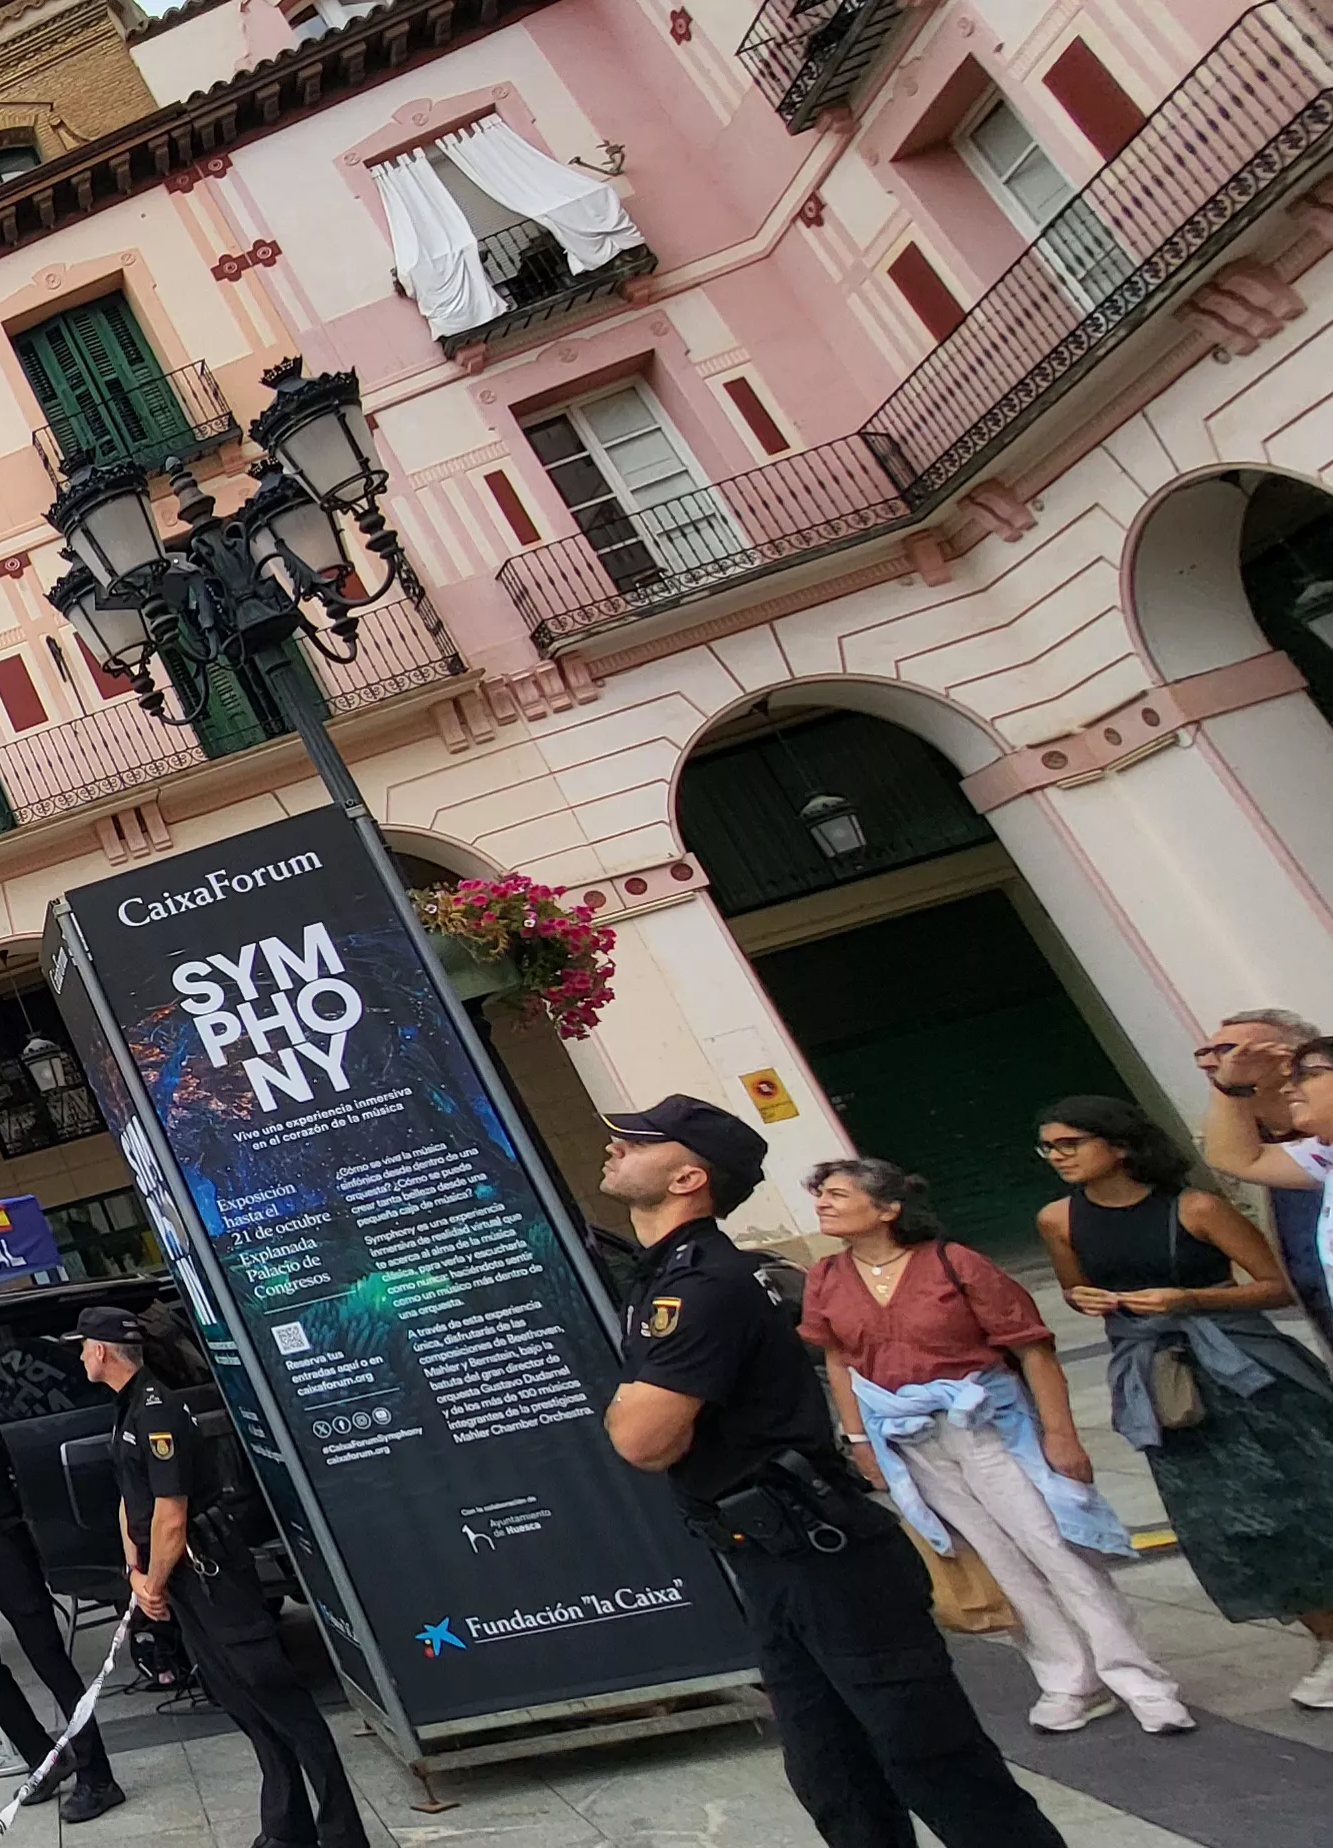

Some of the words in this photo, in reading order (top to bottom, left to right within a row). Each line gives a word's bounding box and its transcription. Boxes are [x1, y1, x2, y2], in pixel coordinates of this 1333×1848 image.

[117, 851, 323, 928] CaixaForum
[171, 921, 346, 1015] SYM
[192, 977, 363, 1068] PHO
[241, 1032, 351, 1113] NY
[233, 1130, 259, 1142] Vive
[262, 1124, 284, 1134] una
[285, 1103, 353, 1128] experiencia
[353, 1088, 412, 1108] inmersiva
[252, 1140, 267, 1150] en
[269, 1134, 281, 1145] el
[282, 1124, 329, 1141] corazón
[331, 1118, 346, 1128] de
[347, 1113, 360, 1123] la
[361, 1103, 404, 1120] música
[216, 1181, 297, 1213] Exposición
[222, 1206, 264, 1229] hasta
[265, 1203, 279, 1217] el
[231, 1229, 251, 1246] 21
[255, 1225, 274, 1240] de
[275, 1212, 331, 1233] octubre
[239, 1236, 318, 1269] Explanada
[246, 1260, 300, 1282] Palacio
[302, 1254, 321, 1268] de
[254, 1273, 330, 1300] Congresos
[285, 1355, 327, 1370] Reserva
[326, 1350, 344, 1360] tus
[292, 1367, 336, 1383] entradas
[337, 1359, 359, 1372] aquí
[369, 1355, 383, 1364] en
[297, 1373, 374, 1395] caixaforum.org
[490, 1510, 552, 1528] Ayuntamiento
[493, 1529, 505, 1538] de
[505, 1522, 542, 1535] Huesca
[465, 1602, 584, 1638] Fundación
